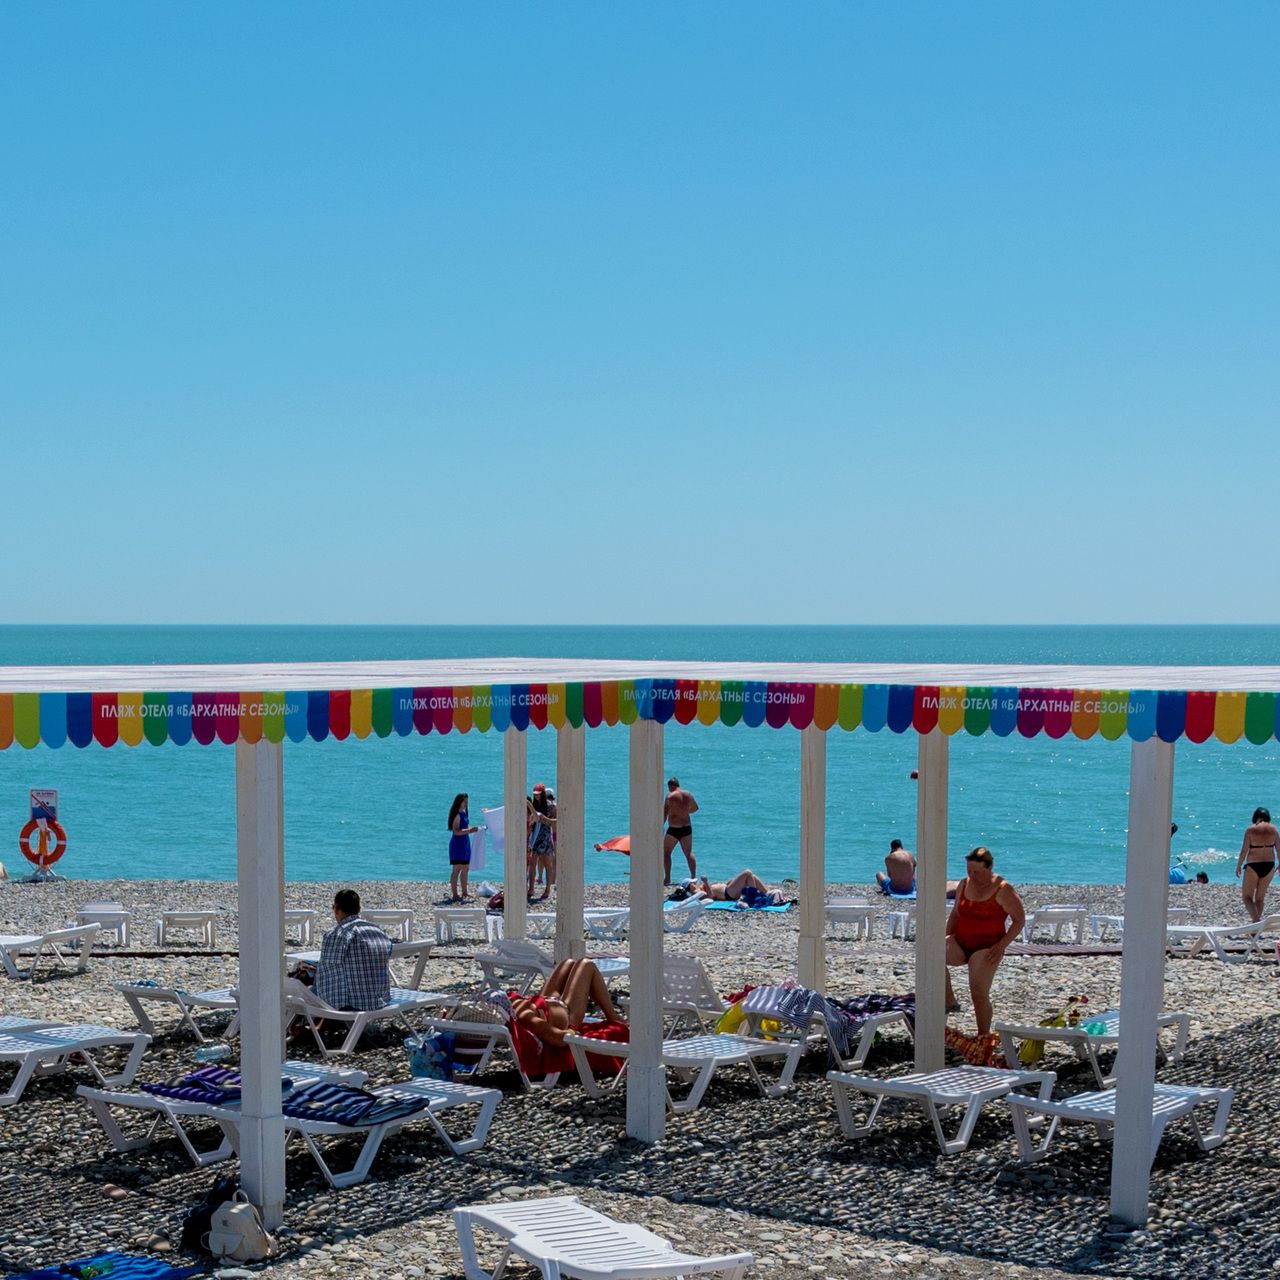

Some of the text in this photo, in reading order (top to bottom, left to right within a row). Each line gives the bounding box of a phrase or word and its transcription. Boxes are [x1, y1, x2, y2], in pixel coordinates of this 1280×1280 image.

[399, 693, 559, 711] ПЛЯЖ ОТЕЛЯ «БАРХАТНЫЕ СЕЗОНЫ»
[649, 689, 681, 701] ОТЕЛЯ
[683, 689, 751, 703] «БАРХАТНЫЕ
[753, 691, 805, 705] СЕЗОНЫ»
[922, 696, 1145, 715] ПЛЯЖ ОТЕЛЯ «БАРХАТНЫЕ СЕЗОНЫ»
[101, 703, 299, 718] ПЛЯЖ ОТЕЛЯ «БАРХАТНЫЕ СЕЗОНЫ»
